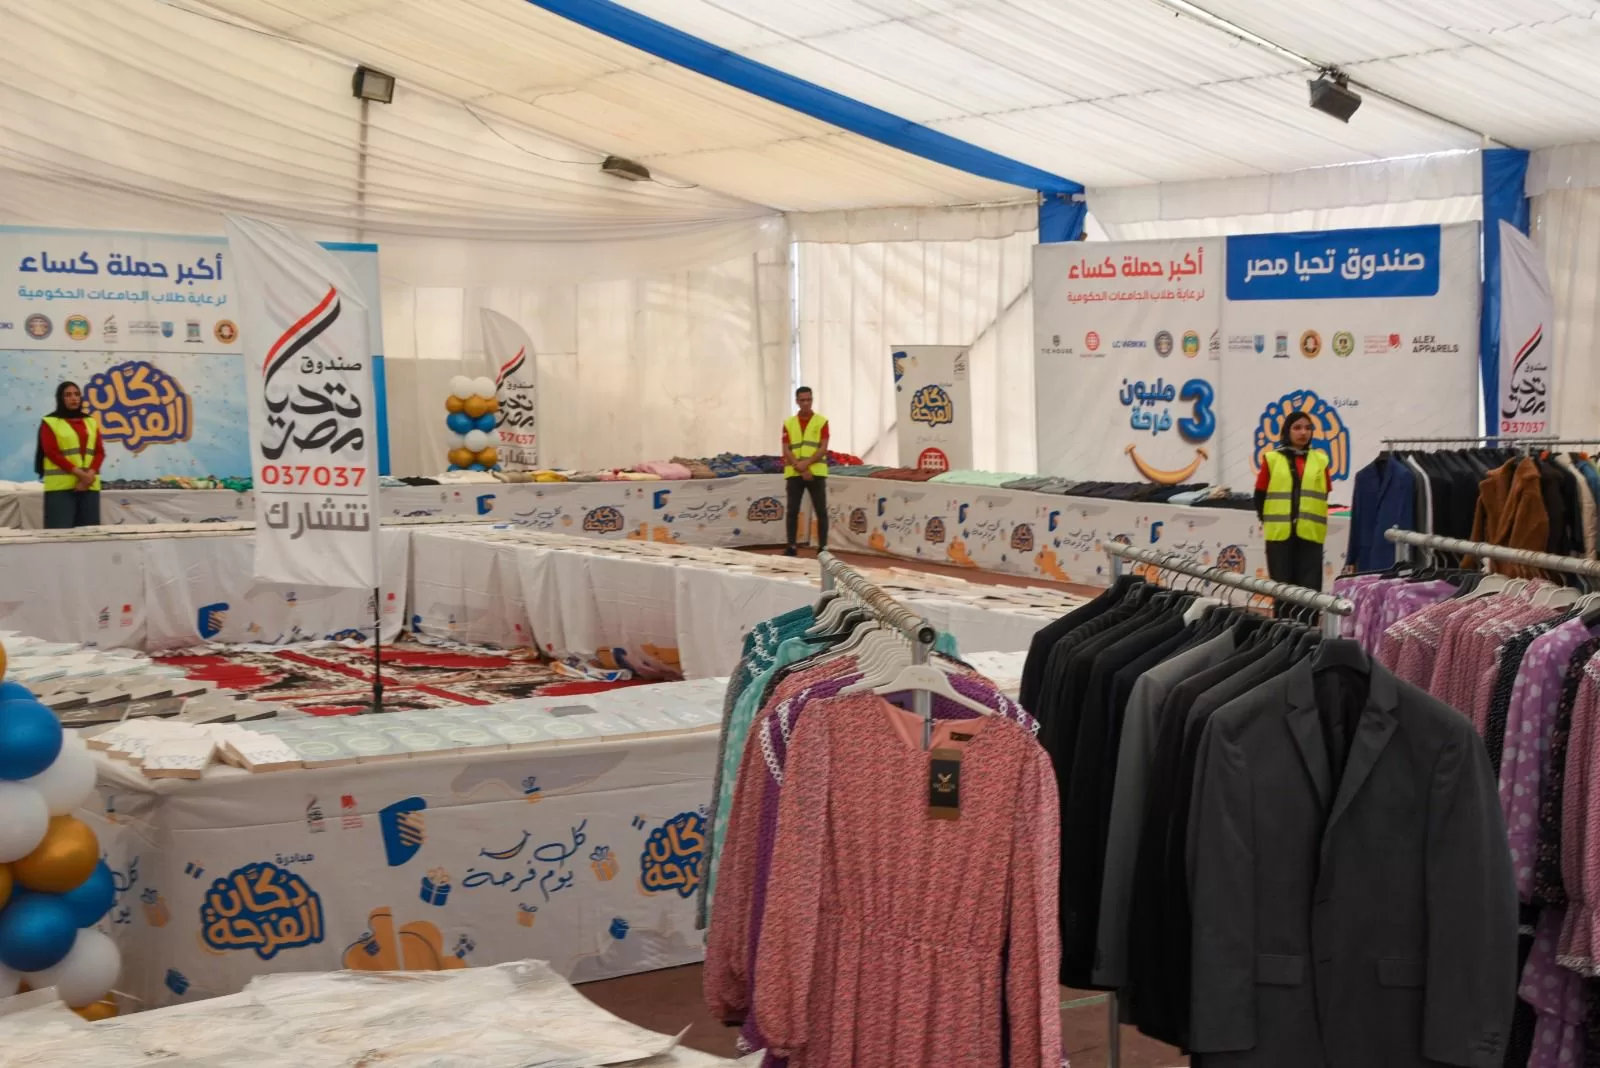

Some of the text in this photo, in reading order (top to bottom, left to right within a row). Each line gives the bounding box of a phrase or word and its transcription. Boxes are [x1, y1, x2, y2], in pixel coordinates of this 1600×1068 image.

[19, 251, 223, 285] أكبر حملة كساء
[1068, 247, 1204, 282] أكبر حملة كساء
[1244, 248, 1426, 283] صندوق تحيا مصر
[18, 286, 227, 306] لرعاية طلاب الجامعات الحكومية
[1067, 288, 1205, 304] لرعاية طلاب الجامعات الحكومية
[1412, 335, 1436, 344] ALEX
[1412, 344, 1460, 354] APPARELS
[301, 357, 363, 374] صندوق
[1119, 377, 1176, 407] مليون
[1130, 407, 1173, 436] فرحة
[1178, 378, 1216, 444] 3
[261, 417, 365, 461] مصر
[498, 431, 537, 445] 37037
[261, 465, 367, 488] 037037
[264, 498, 370, 540] نتشارك
[533, 819, 588, 863] كل
[275, 853, 315, 866] مبادرة
[462, 859, 574, 902] يوم فرحة
